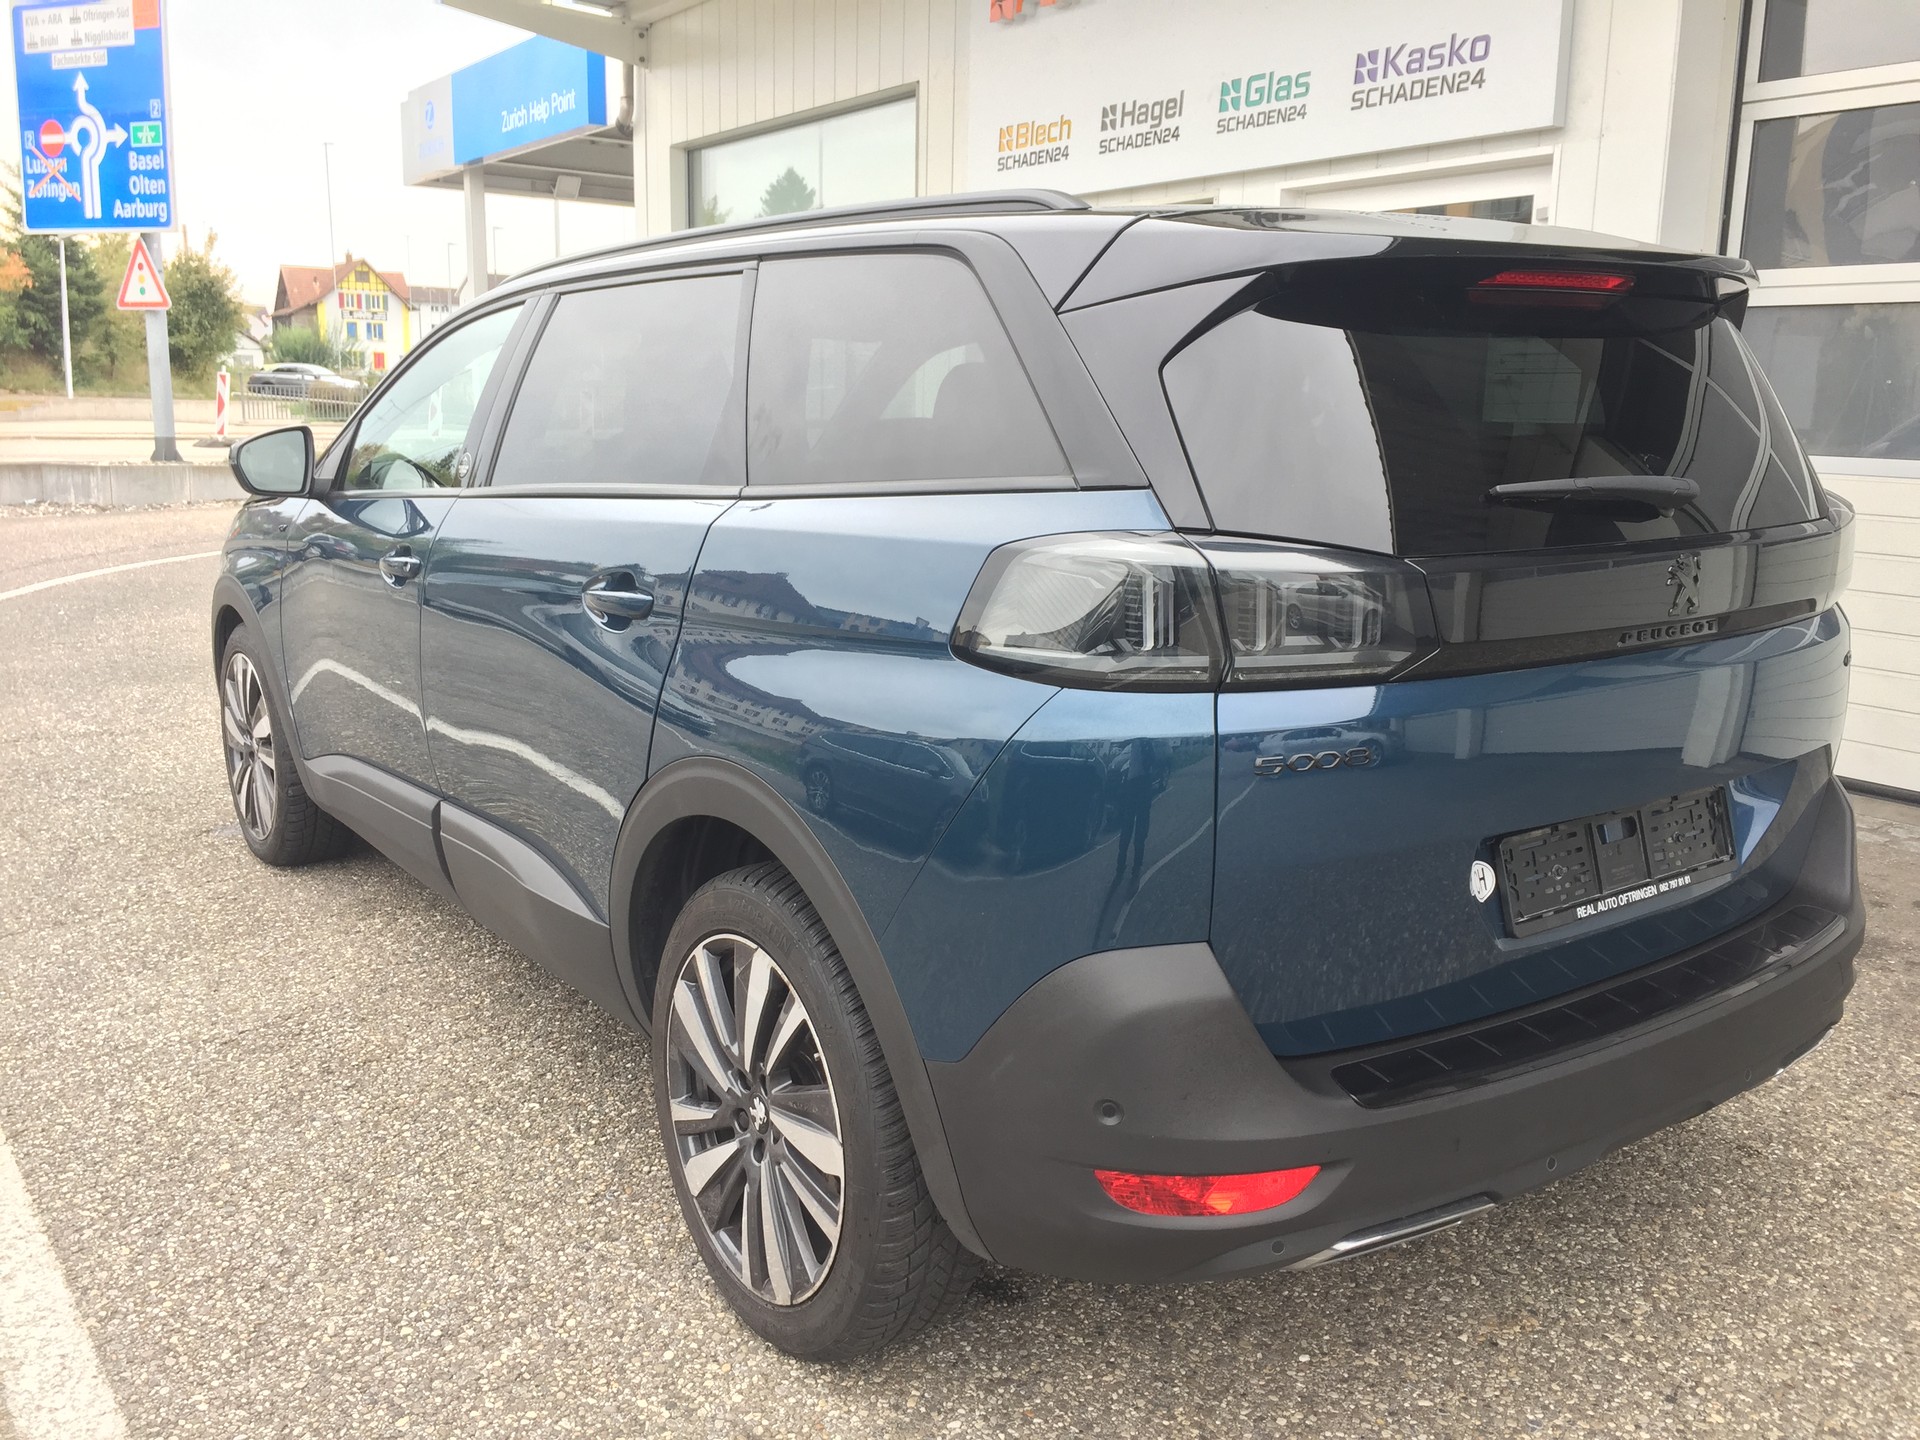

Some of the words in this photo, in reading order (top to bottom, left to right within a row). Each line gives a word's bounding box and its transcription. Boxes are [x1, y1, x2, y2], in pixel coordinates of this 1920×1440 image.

[25, 16, 39, 27] KVA
[48, 13, 63, 25] ARA
[83, 7, 130, 23] Oftringen-Süd
[40, 34, 59, 47] Brühl
[93, 51, 106, 63] Süd
[1382, 33, 1492, 79] Kasko
[1245, 71, 1311, 108] Glas
[1350, 67, 1486, 111] SCHADEN24
[501, 104, 528, 133] Zurich
[529, 97, 550, 124] Help
[551, 88, 576, 116] Point
[1120, 90, 1185, 129] Hagel
[1216, 104, 1308, 134] SCHADEN24
[1016, 114, 1072, 149] Blech
[1099, 126, 1180, 155] SCHADEN24
[128, 149, 165, 171] Basel
[997, 145, 1070, 172] SCHADEN24
[128, 173, 166, 195] Olten
[113, 197, 168, 223] Aarburg
[1618, 619, 1718, 647] PEUGEOT
[1254, 747, 1372, 776] 5008
[1576, 903, 1597, 919] REAL
[1598, 897, 1618, 913] AUTO
[1618, 884, 1658, 906] OFTRINGEN
[1659, 882, 1669, 892] 062
[1669, 879, 1678, 889] 797
